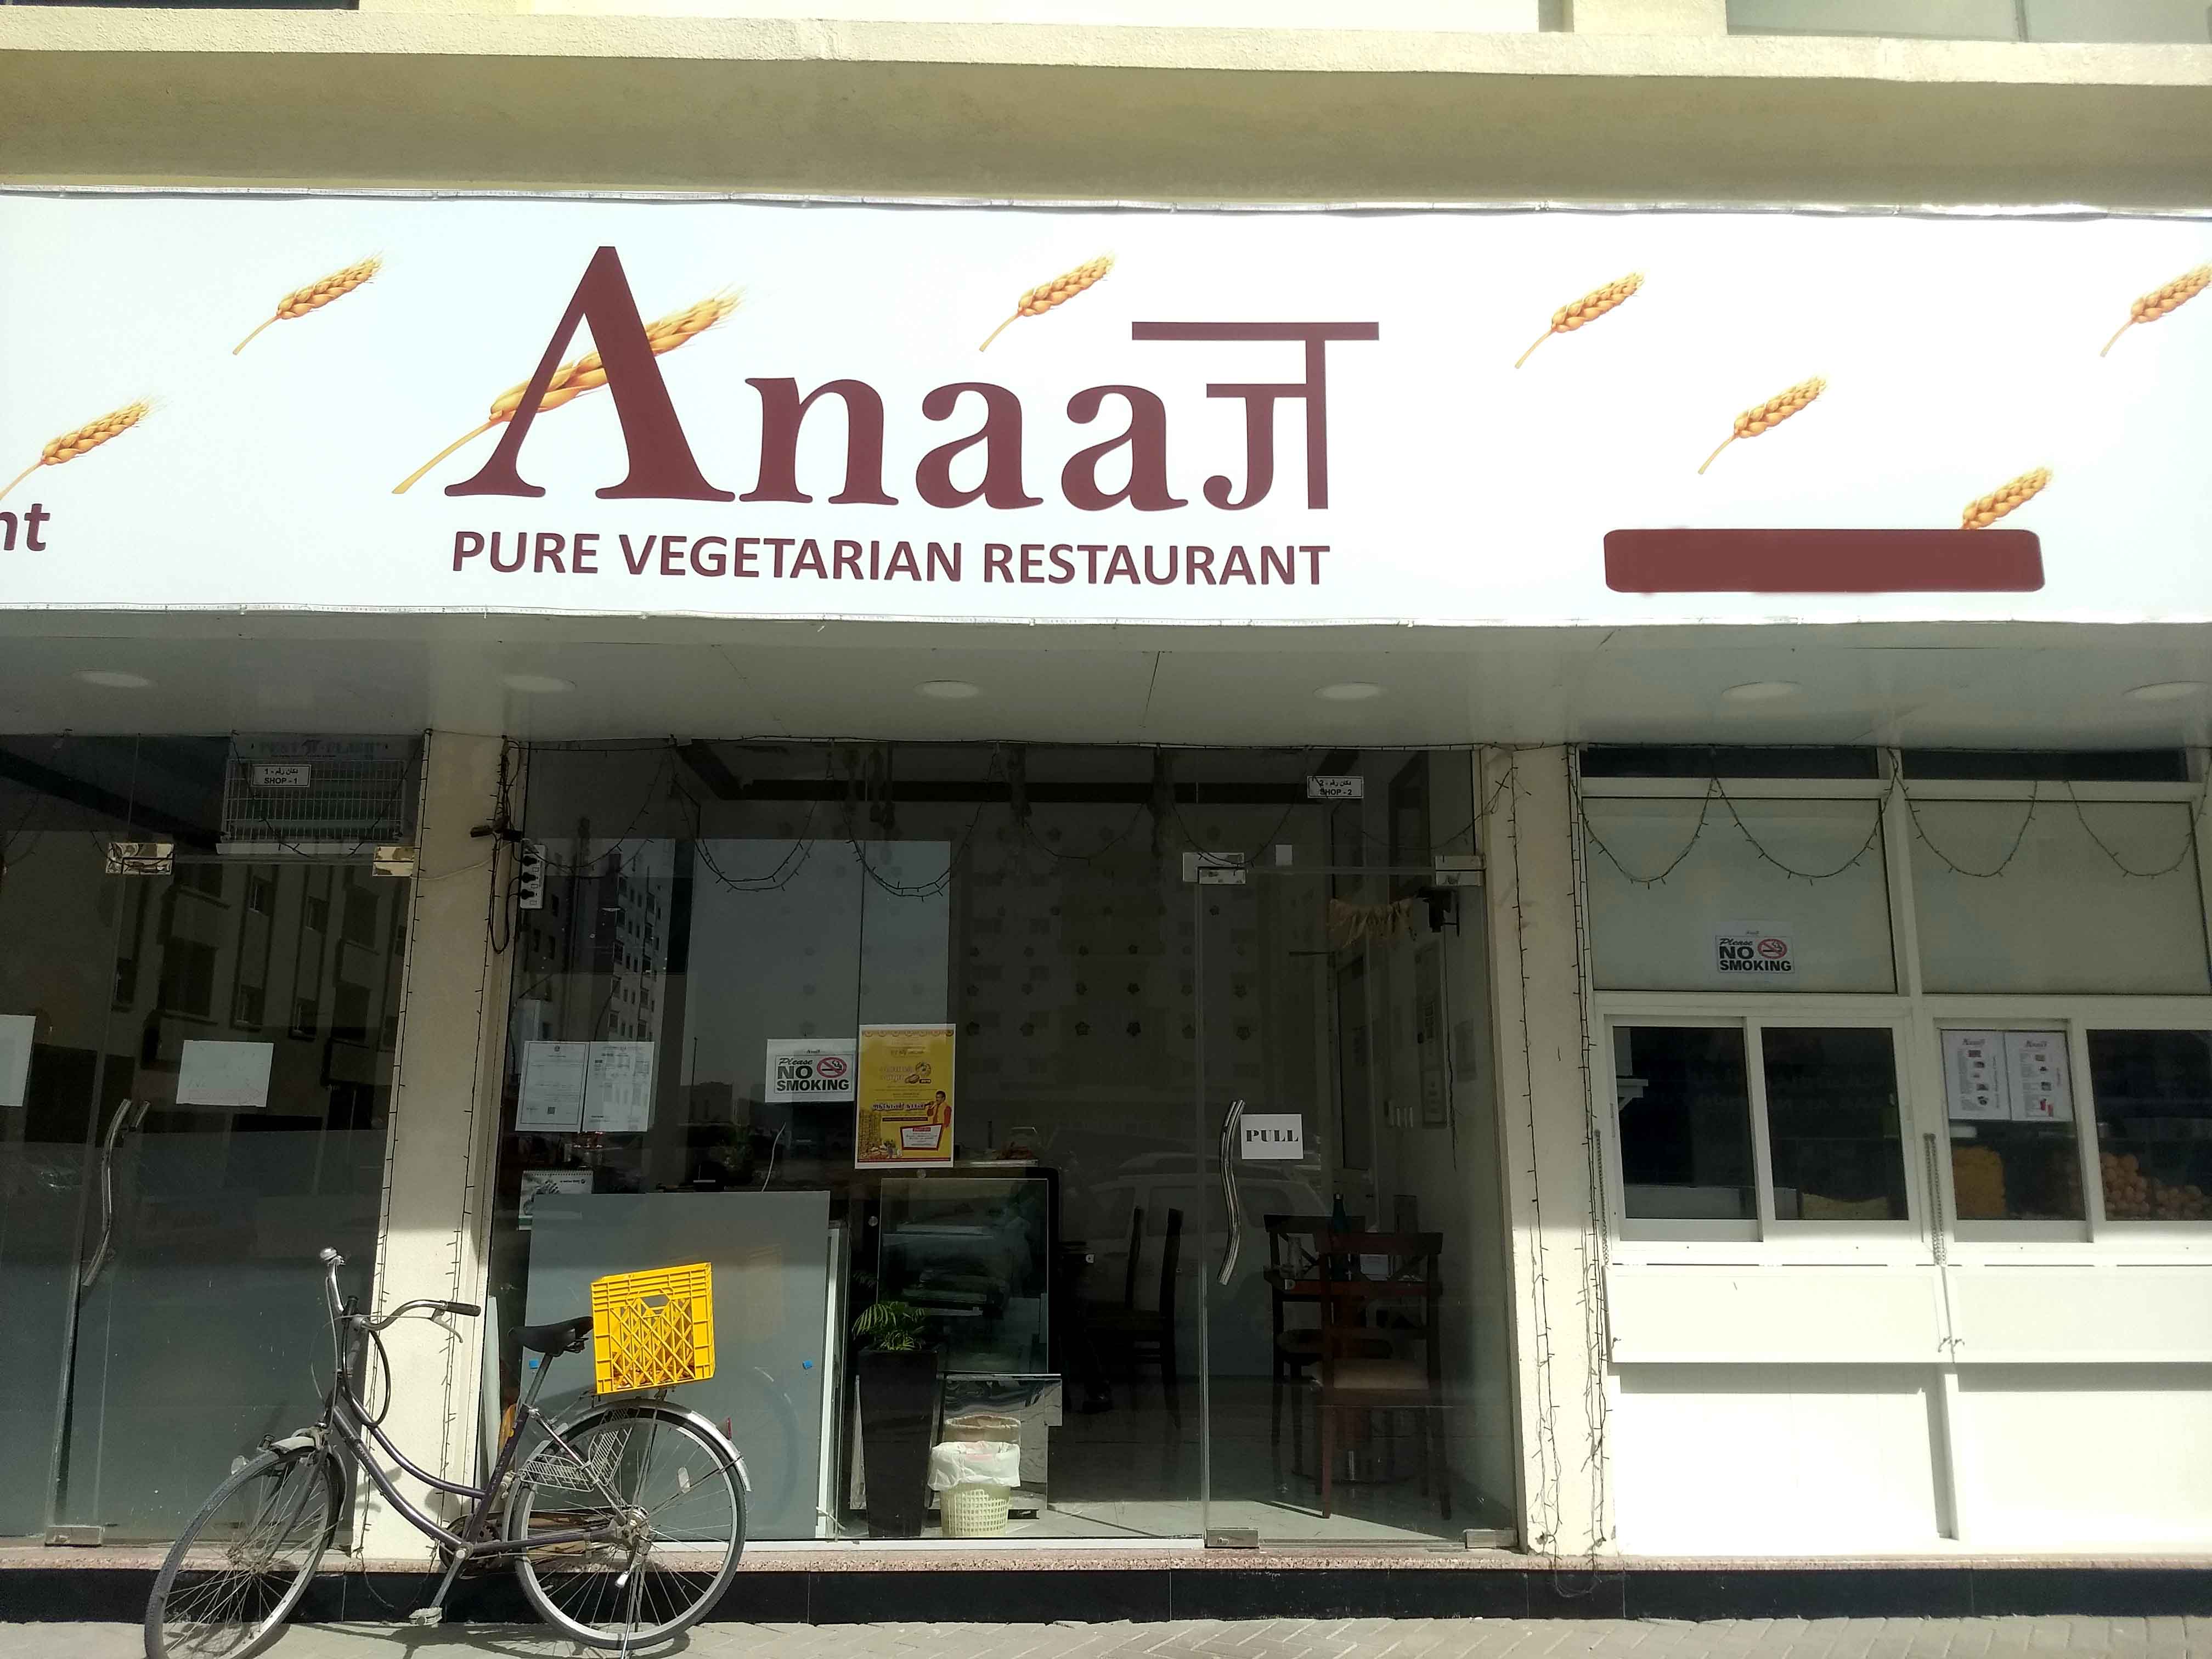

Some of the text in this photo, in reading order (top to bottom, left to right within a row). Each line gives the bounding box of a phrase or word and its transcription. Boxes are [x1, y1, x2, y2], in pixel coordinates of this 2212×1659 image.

[453, 531, 1330, 585] PURE VEGETARIAN RESTAURANT
[1719, 938, 1753, 946] Please
[1719, 946, 1754, 960] NO
[1719, 960, 1792, 972] SMOKING
[777, 1065, 813, 1080] NO
[776, 1079, 849, 1092] SMOKING
[1246, 1130, 1299, 1142] PULL
